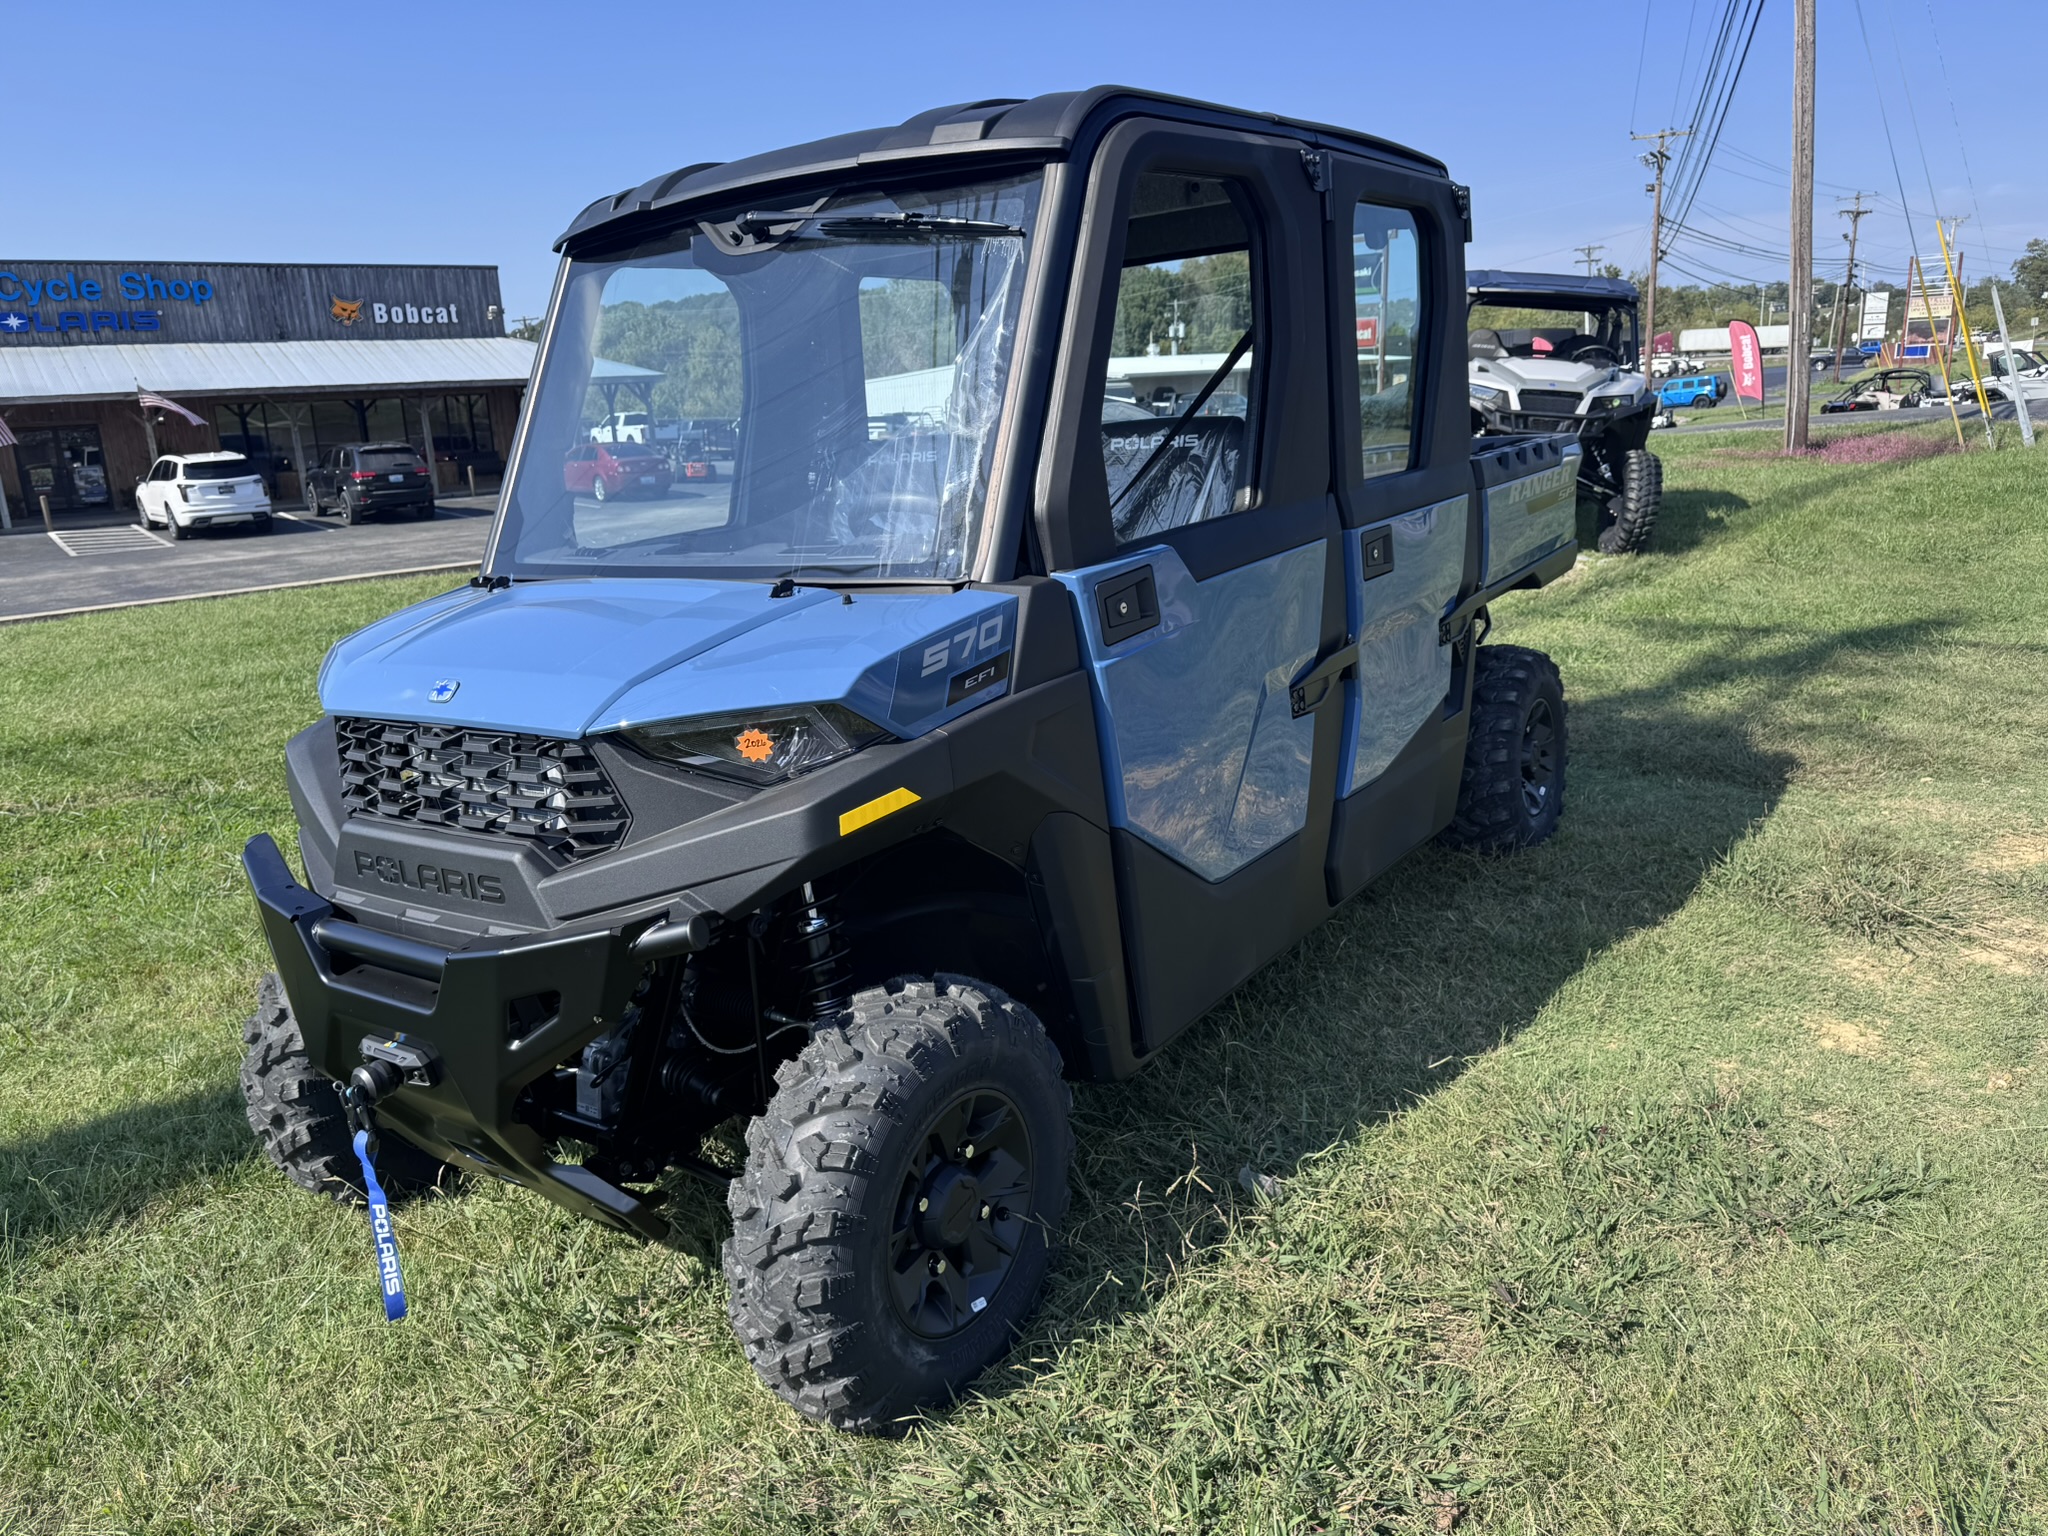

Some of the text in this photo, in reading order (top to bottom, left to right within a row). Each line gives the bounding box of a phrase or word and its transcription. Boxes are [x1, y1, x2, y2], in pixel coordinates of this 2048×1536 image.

[0, 272, 213, 307] Cycle Shop
[0, 310, 161, 333] OLARIS
[372, 302, 459, 324] Bobcat
[1739, 334, 1754, 370] Bobcat
[1508, 465, 1571, 505] RANGER
[1558, 486, 1575, 501] SP
[964, 666, 995, 689] EFI
[744, 738, 768, 749] 2026
[354, 850, 506, 906] POLARIS
[371, 1204, 401, 1296] POLARIS
